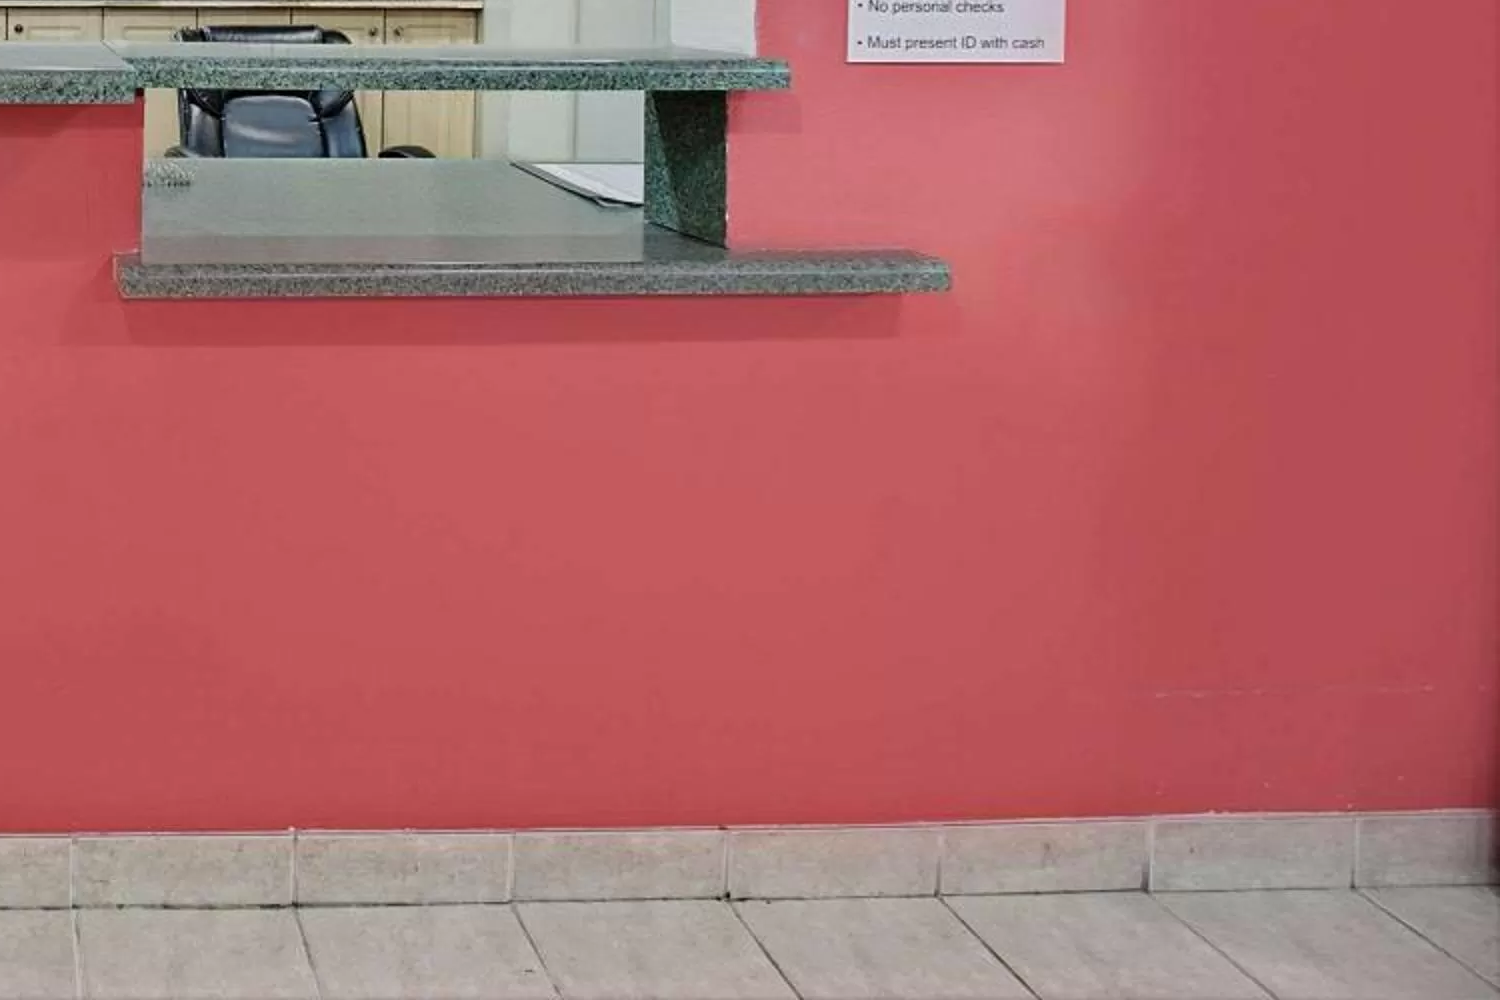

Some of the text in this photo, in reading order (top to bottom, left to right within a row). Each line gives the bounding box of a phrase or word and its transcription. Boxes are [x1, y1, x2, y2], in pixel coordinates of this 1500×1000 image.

[868, 0, 1004, 15] No personal checks
[867, 36, 1044, 50] Must present ID with cash
